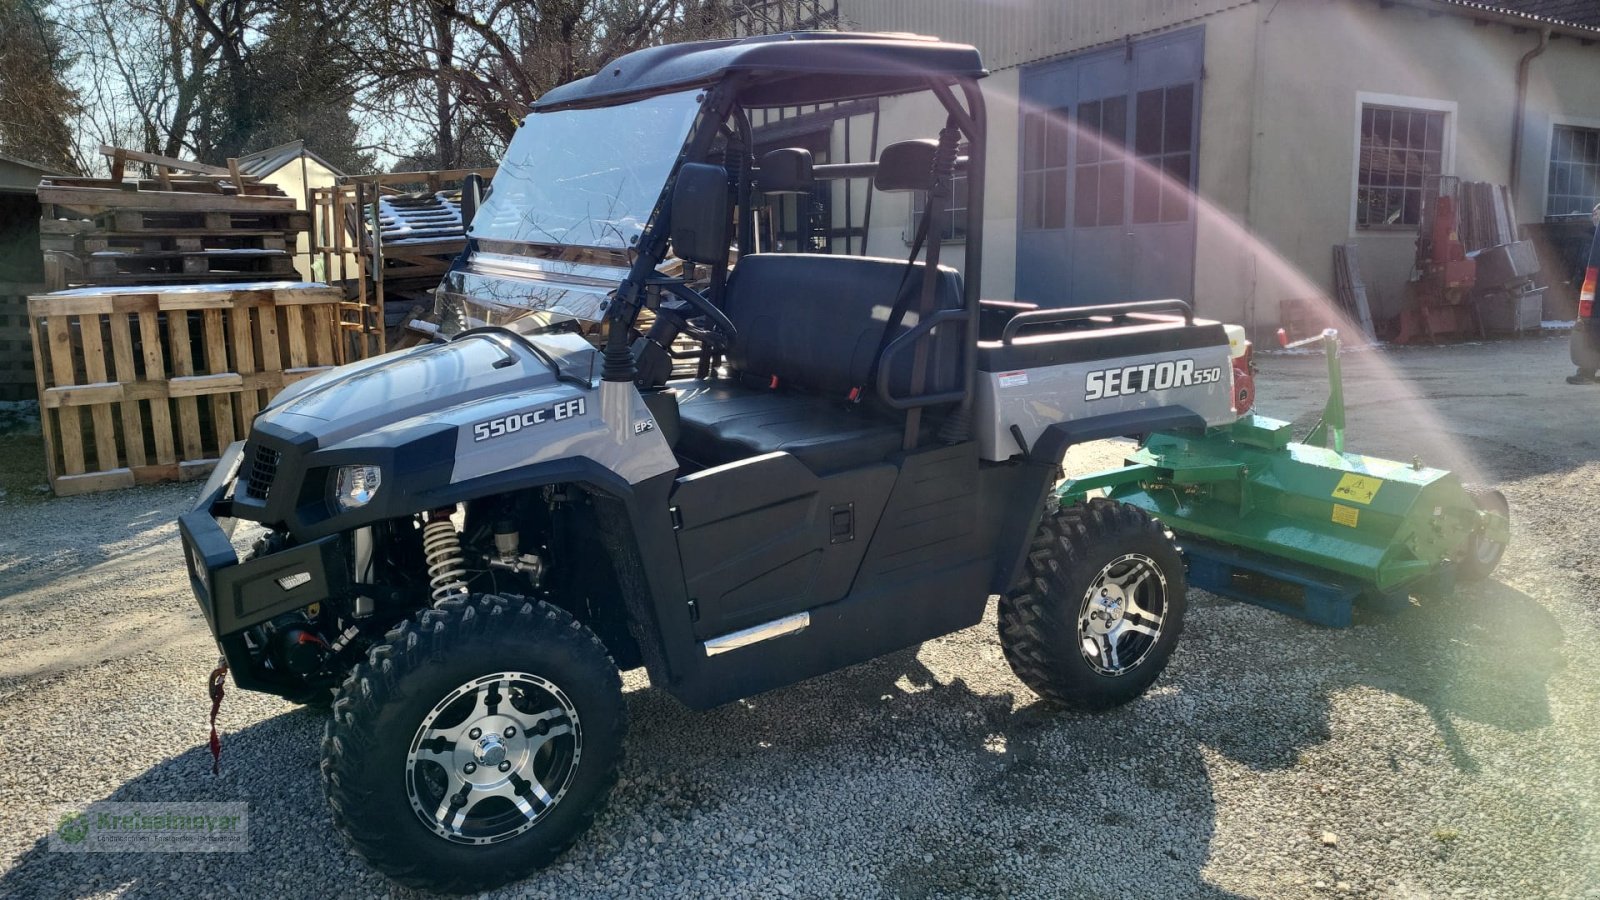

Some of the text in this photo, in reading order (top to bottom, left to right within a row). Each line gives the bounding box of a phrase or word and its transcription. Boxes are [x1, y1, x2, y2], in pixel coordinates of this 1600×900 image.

[1085, 359, 1221, 401] SECTOR 550
[474, 398, 585, 442] 550cc EFI
[634, 419, 653, 434] EPS
